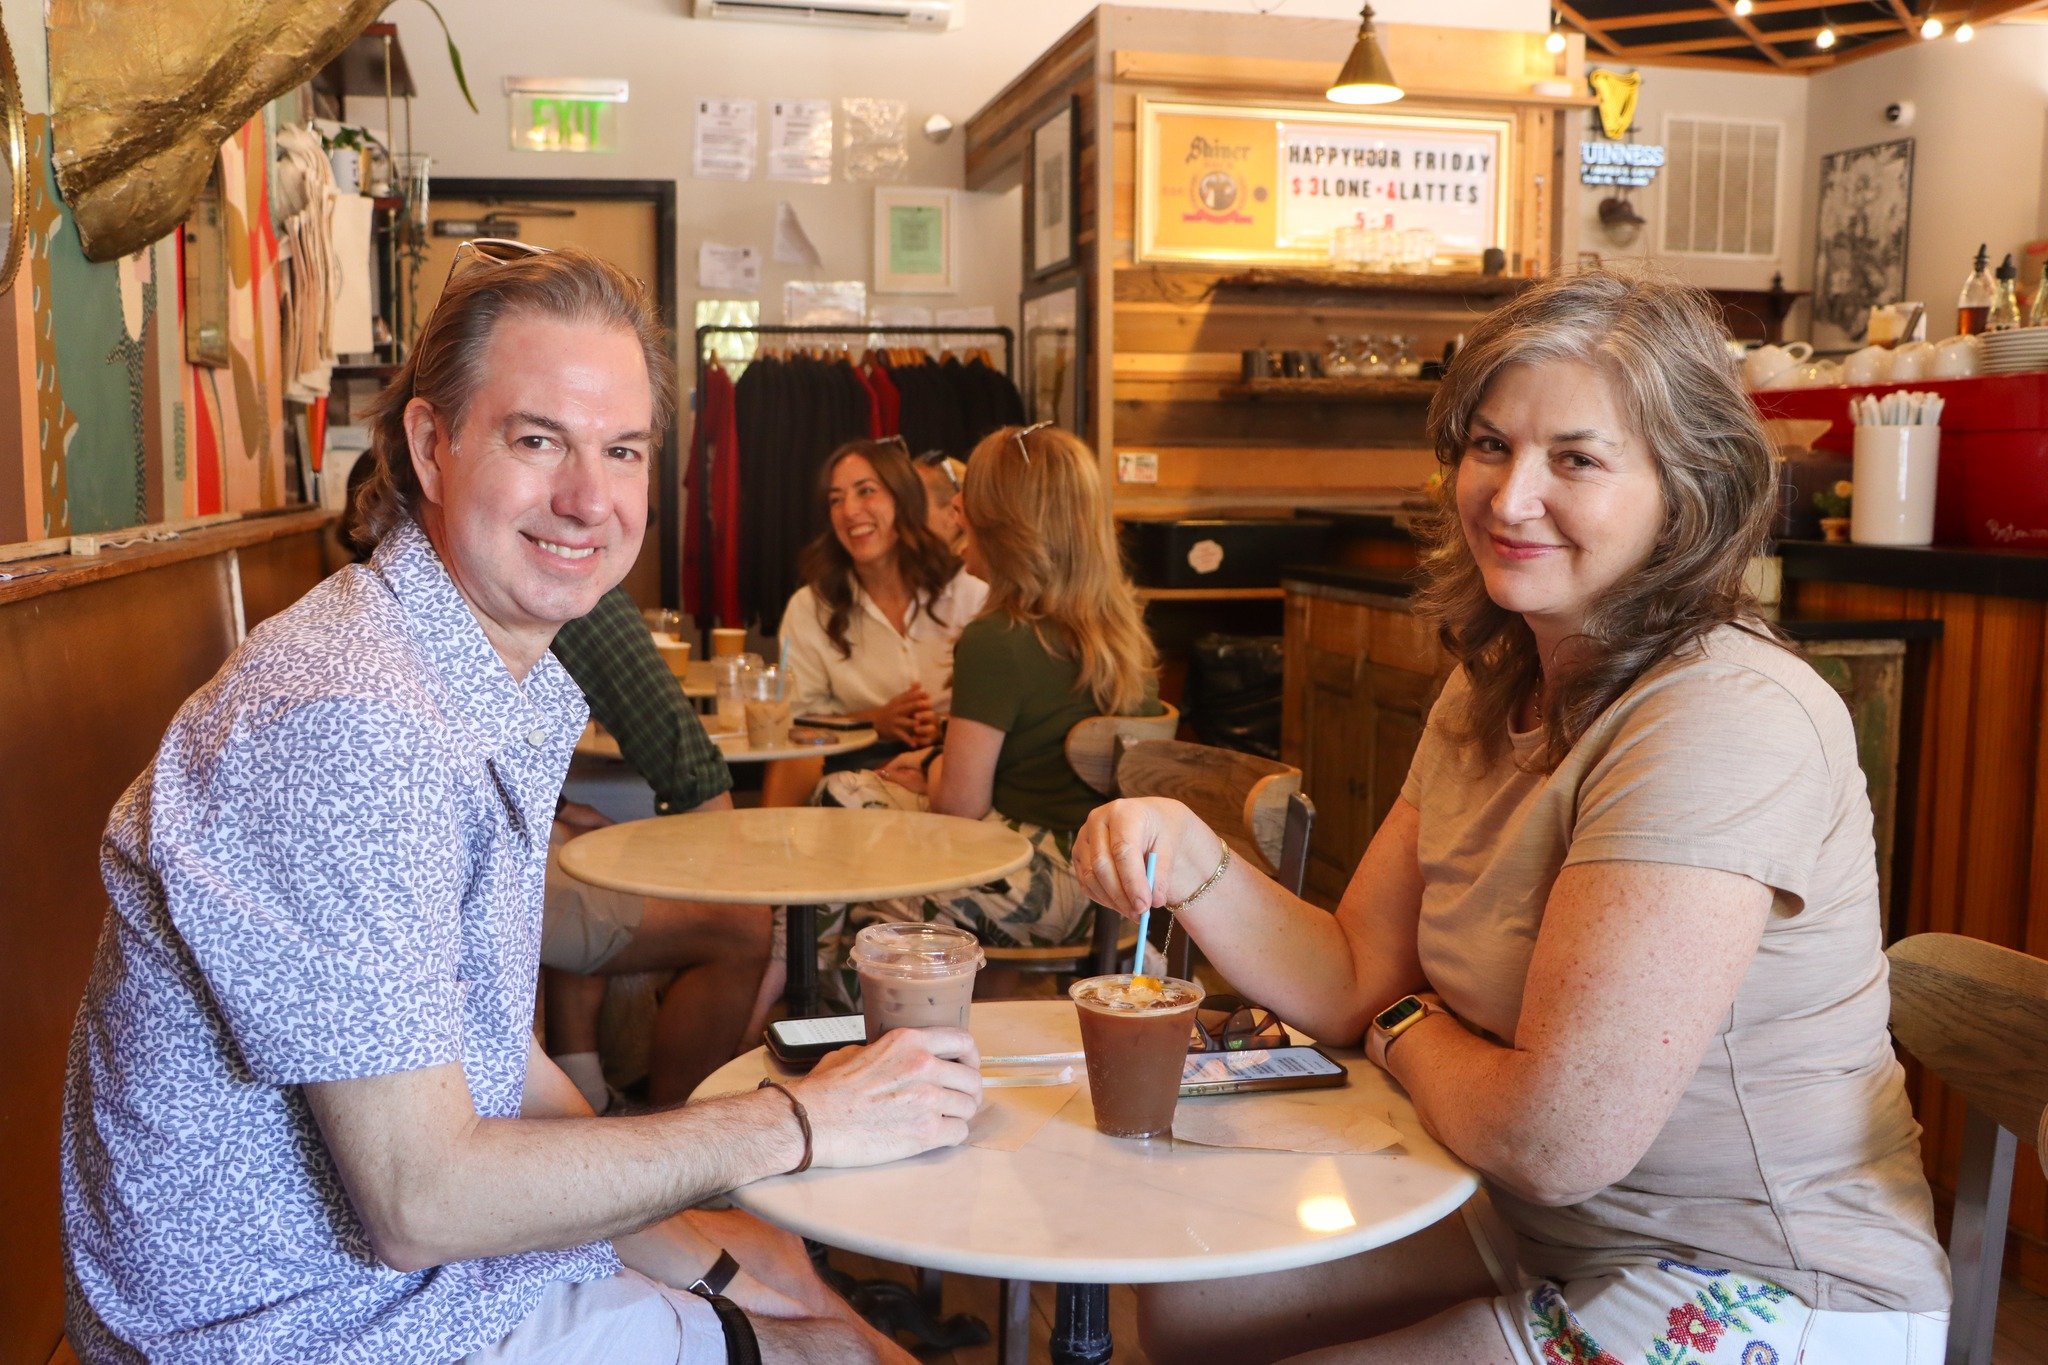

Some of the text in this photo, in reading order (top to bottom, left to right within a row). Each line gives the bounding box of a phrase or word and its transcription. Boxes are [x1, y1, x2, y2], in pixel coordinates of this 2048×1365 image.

[531, 99, 606, 146] EXIT
[1185, 136, 1250, 162] Shiner
[1414, 151, 1490, 172] FRIDAY
[1579, 142, 1664, 168] UINNESS
